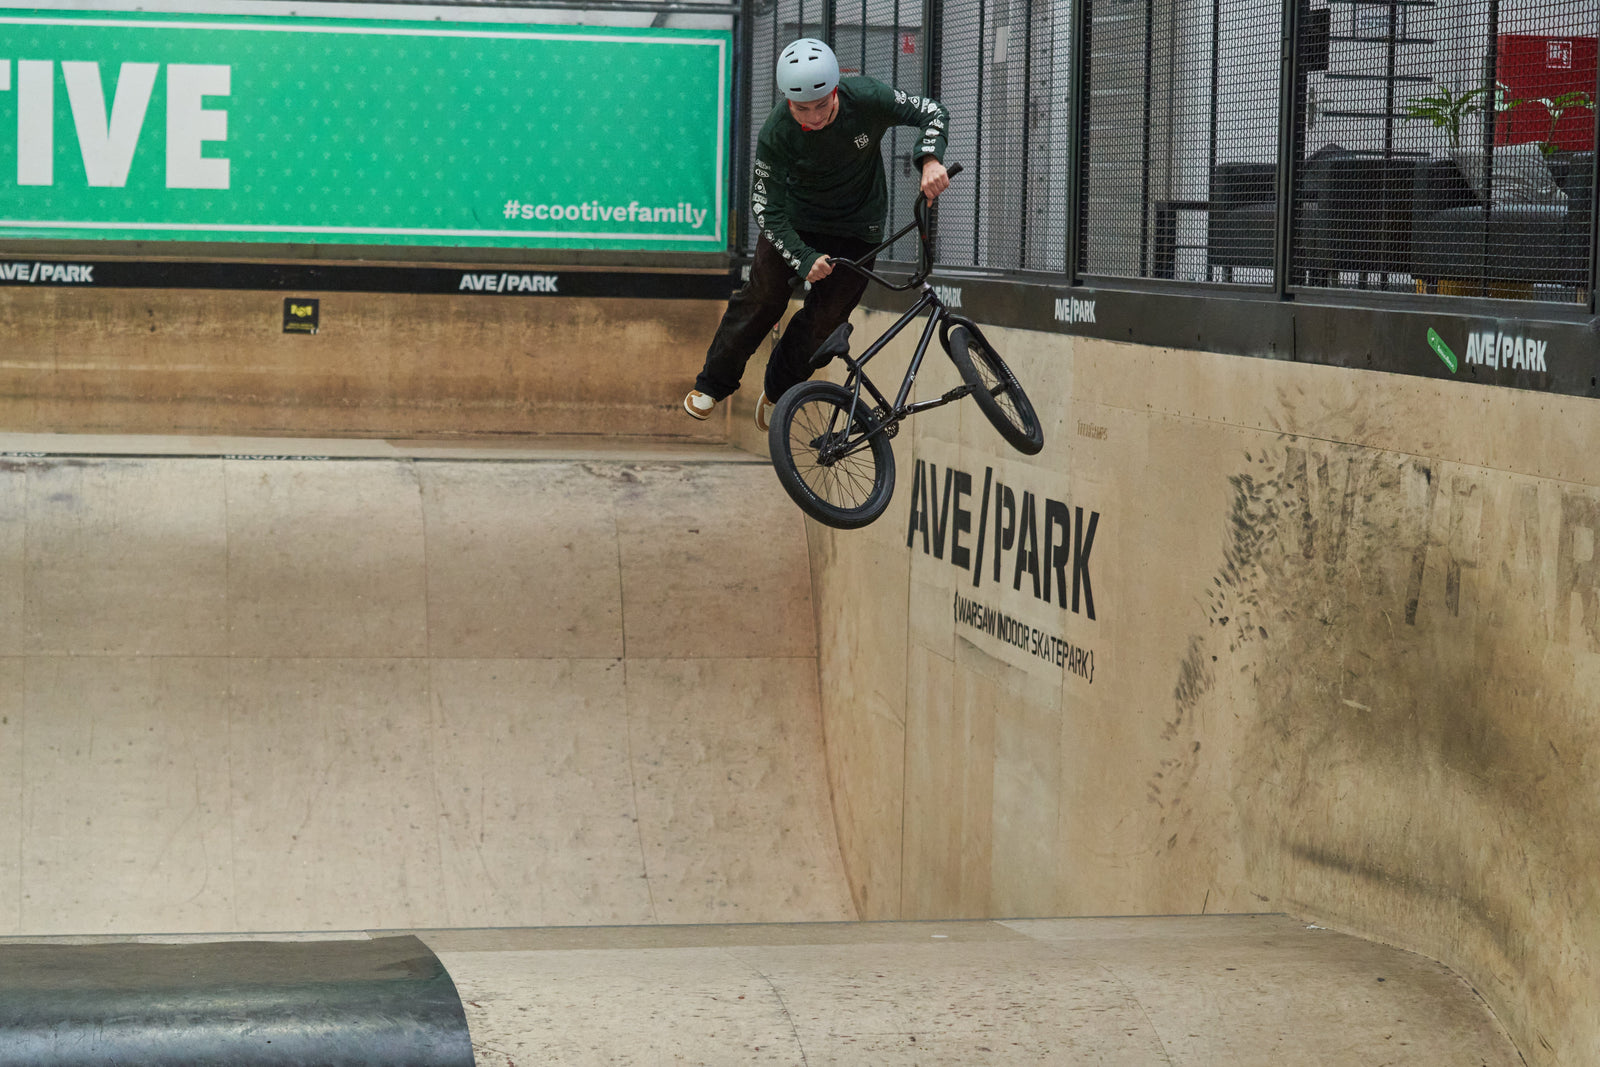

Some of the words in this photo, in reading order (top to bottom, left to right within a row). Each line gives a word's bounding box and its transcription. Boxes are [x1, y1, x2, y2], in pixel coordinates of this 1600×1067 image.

[0, 59, 231, 190] IVE
[854, 134, 870, 149] TSG
[503, 200, 707, 229] #scootivefamily
[459, 273, 559, 293] AVE/PARK
[1054, 296, 1096, 324] AVE/PARK
[1465, 332, 1548, 373] AVE/PARK
[906, 458, 1100, 622] AVE/PARK
[997, 611, 1030, 653] INDOOR
